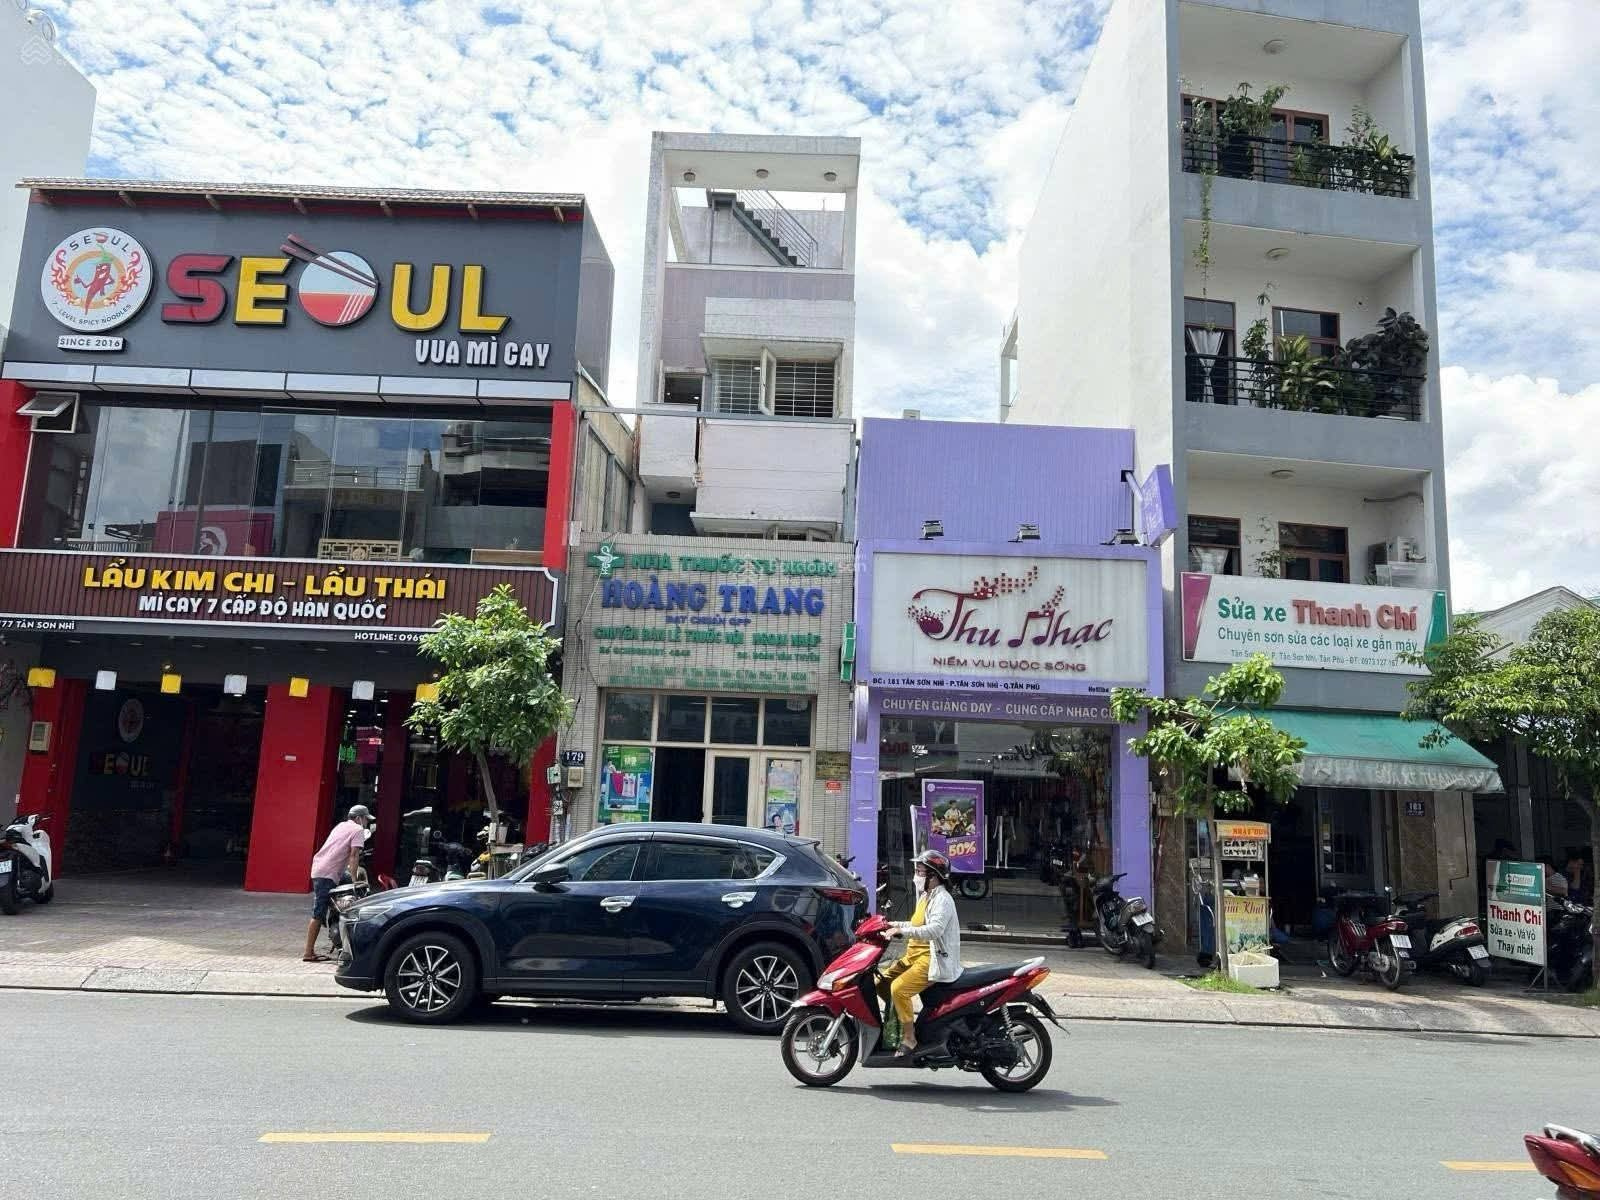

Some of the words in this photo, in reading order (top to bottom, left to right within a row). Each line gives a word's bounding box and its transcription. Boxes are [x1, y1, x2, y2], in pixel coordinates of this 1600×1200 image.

[161, 240, 512, 334] SEOUL
[78, 317, 100, 326] SPICY
[101, 303, 132, 324] NOODLES
[59, 338, 92, 347] SINCE
[95, 339, 121, 348] 2016
[415, 339, 460, 365] VUA
[467, 335, 498, 366] MÌ
[504, 343, 550, 368] CAY
[632, 552, 672, 571] NHÀ
[84, 559, 146, 589] LẨU
[151, 570, 215, 591] KIM
[223, 572, 275, 594] CHI
[304, 566, 366, 598] LẨU
[374, 573, 446, 600] THÁI
[601, 574, 708, 611] HOÀNG
[718, 583, 825, 617] TRANG
[139, 592, 162, 611] MÌ
[165, 597, 203, 613] CAY
[207, 598, 218, 614] 7
[222, 594, 257, 616] CẤP
[260, 596, 288, 620] ĐỘ
[292, 597, 329, 618] HÀN
[333, 599, 387, 620] QUỐC
[1218, 597, 1256, 620] Sửa
[1263, 606, 1287, 622] xe
[1292, 599, 1371, 629] Thanh
[1377, 604, 1418, 632] Chí
[0, 620, 13, 628] 77
[16, 619, 34, 629] TÂN
[37, 621, 57, 629] SƠN
[58, 621, 75, 630] NHÌ
[912, 588, 1000, 647] Thu
[354, 632, 398, 642] HOTLINE:
[1218, 627, 1260, 644] Chuyên
[1264, 632, 1284, 643] sơn
[1288, 630, 1307, 646] sửa
[1311, 633, 1330, 647] các
[1333, 635, 1353, 650] loại
[1356, 638, 1369, 648] xe
[1372, 635, 1392, 652] gắn
[1395, 639, 1418, 654] máy
[973, 659, 996, 669] VUI
[902, 678, 915, 686] TÂN
[917, 679, 931, 687] SƠN
[950, 680, 969, 688] P.TÂN
[971, 681, 985, 689] SƠN
[1003, 682, 1024, 691] Q.TÂN
[883, 698, 929, 711] CHUYÊN
[932, 698, 967, 713] GIẢNG
[1006, 703, 1037, 715] CUNG
[1040, 702, 1063, 717] CẤP
[566, 752, 584, 761] 179
[1490, 904, 1520, 922] Thanh
[1524, 909, 1542, 925] Chí
[1490, 923, 1502, 936] Sửa
[1504, 929, 1513, 937] xe
[1517, 928, 1526, 939] Vá
[1497, 939, 1515, 954] Thay
